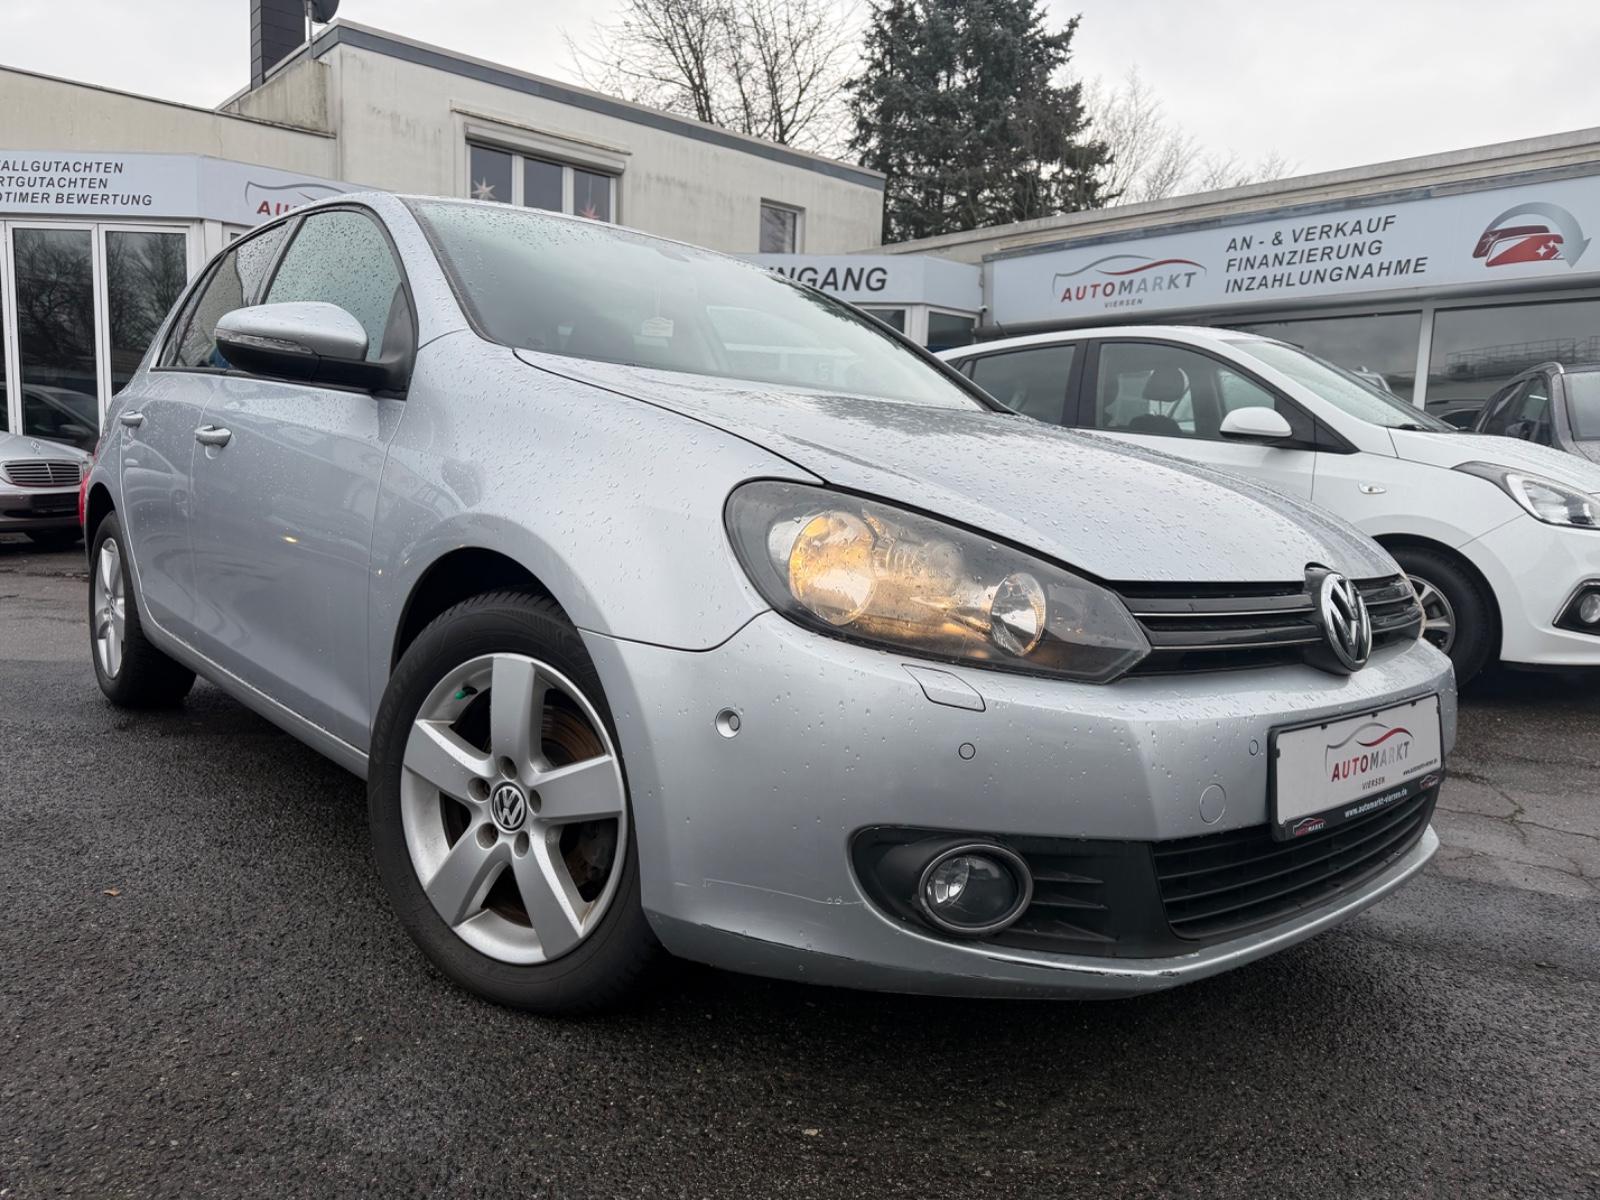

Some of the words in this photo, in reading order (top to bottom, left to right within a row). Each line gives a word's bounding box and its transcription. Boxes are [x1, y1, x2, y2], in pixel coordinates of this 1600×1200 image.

[0, 160, 123, 174] ALLGUTACHTEN
[55, 192, 152, 206] BEWERTUNG
[1225, 235, 1253, 252] AN
[1271, 231, 1283, 246] &
[1291, 215, 1396, 243] VERKAUF
[1225, 239, 1383, 273] FINANZIERUNG
[1060, 271, 1197, 303] AUTOMARKT
[1225, 256, 1428, 294] INZAHLUNGNAHME
[1104, 298, 1143, 308] VIERSEN
[1331, 740, 1410, 782] AUTOMARKT
[1361, 776, 1386, 790] VIERSEN
